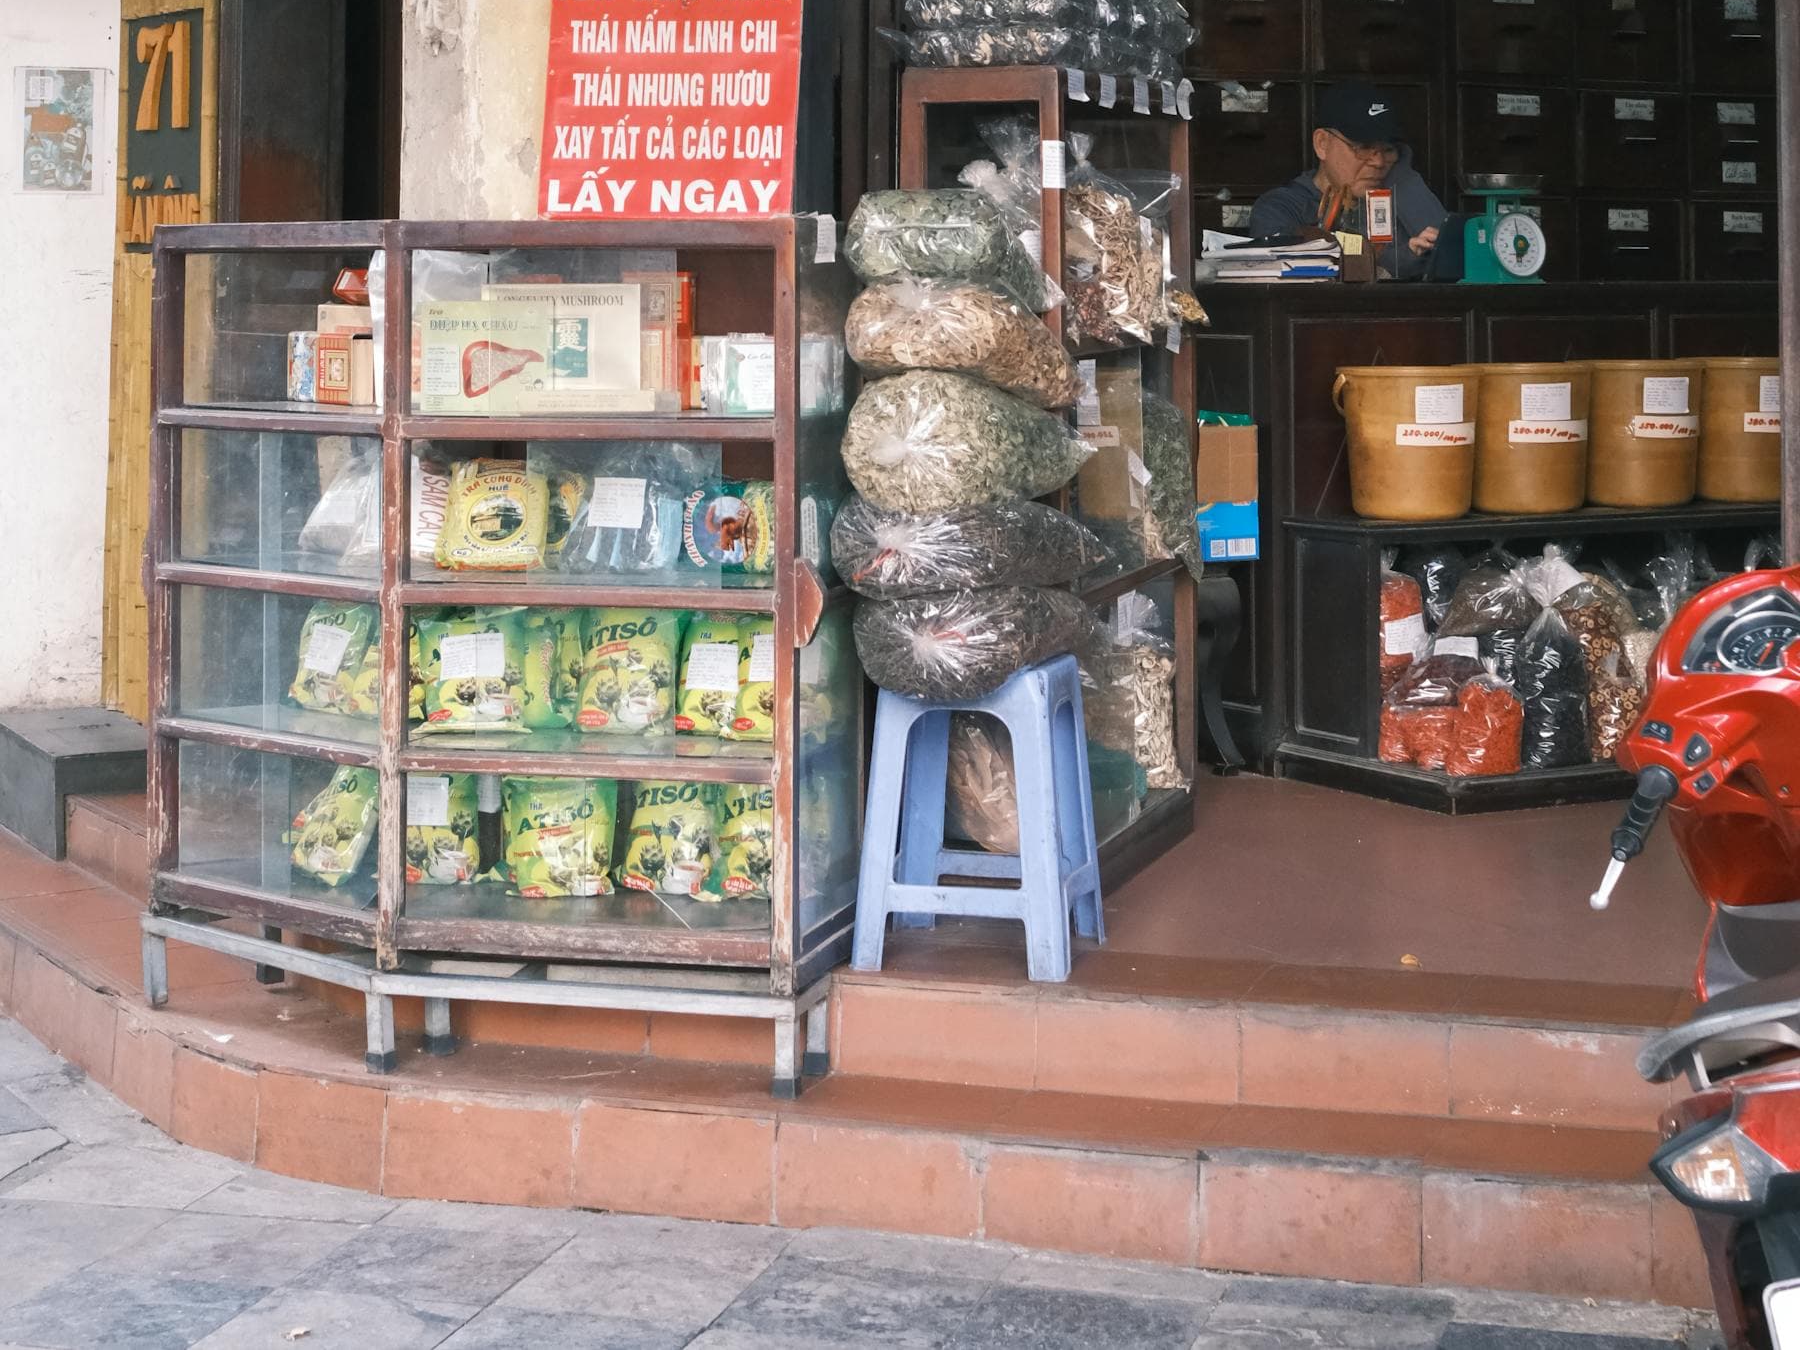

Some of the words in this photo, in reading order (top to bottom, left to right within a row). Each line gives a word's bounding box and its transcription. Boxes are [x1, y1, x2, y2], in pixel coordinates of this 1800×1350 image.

[571, 14, 618, 54] THÁI
[625, 10, 677, 54] NẤM
[683, 20, 734, 53] LINH
[741, 20, 777, 53] CHI
[136, 20, 190, 131] 71
[573, 67, 621, 107] THÁI
[627, 74, 704, 107] NHUNG
[711, 70, 771, 107] HƯƠU
[553, 126, 595, 160] XAY
[602, 114, 640, 160] TẤT
[646, 115, 675, 160] CẢ
[682, 119, 727, 160] CÁC
[733, 125, 783, 166] LOẠI
[547, 167, 637, 213] LẤY
[650, 180, 781, 214] NGAY
[561, 295, 625, 306] MUSHROOM
